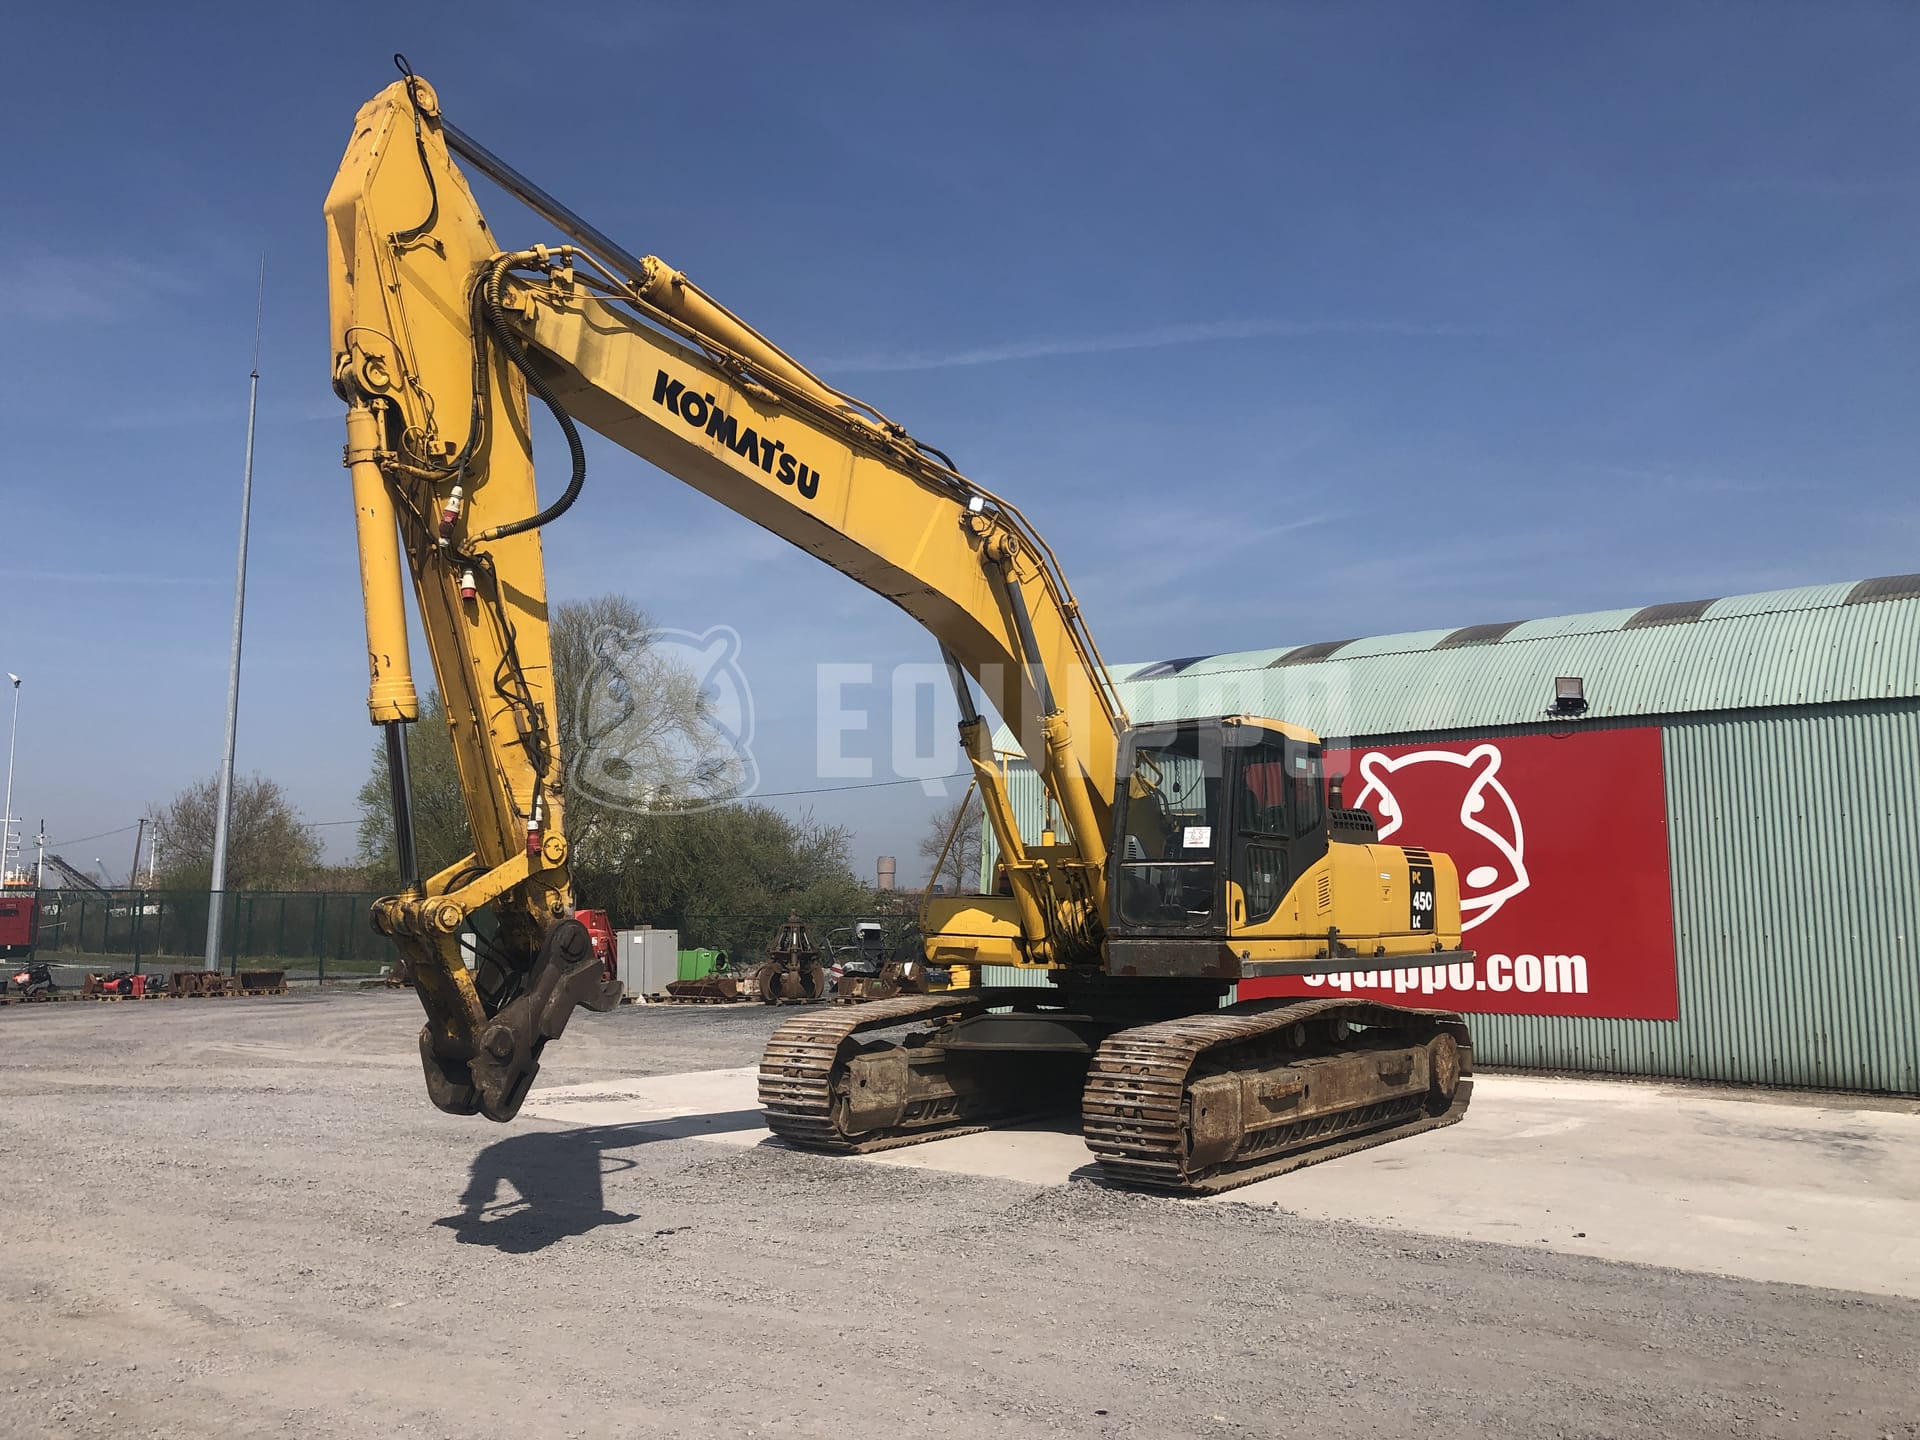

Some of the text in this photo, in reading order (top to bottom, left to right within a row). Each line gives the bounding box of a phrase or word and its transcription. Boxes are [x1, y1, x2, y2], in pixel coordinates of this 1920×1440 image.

[652, 369, 820, 500] KOMATSU
[1412, 871, 1422, 884] PC
[1412, 891, 1433, 911] 450
[1412, 915, 1421, 929] LC
[1302, 953, 1589, 994] ppo.com
